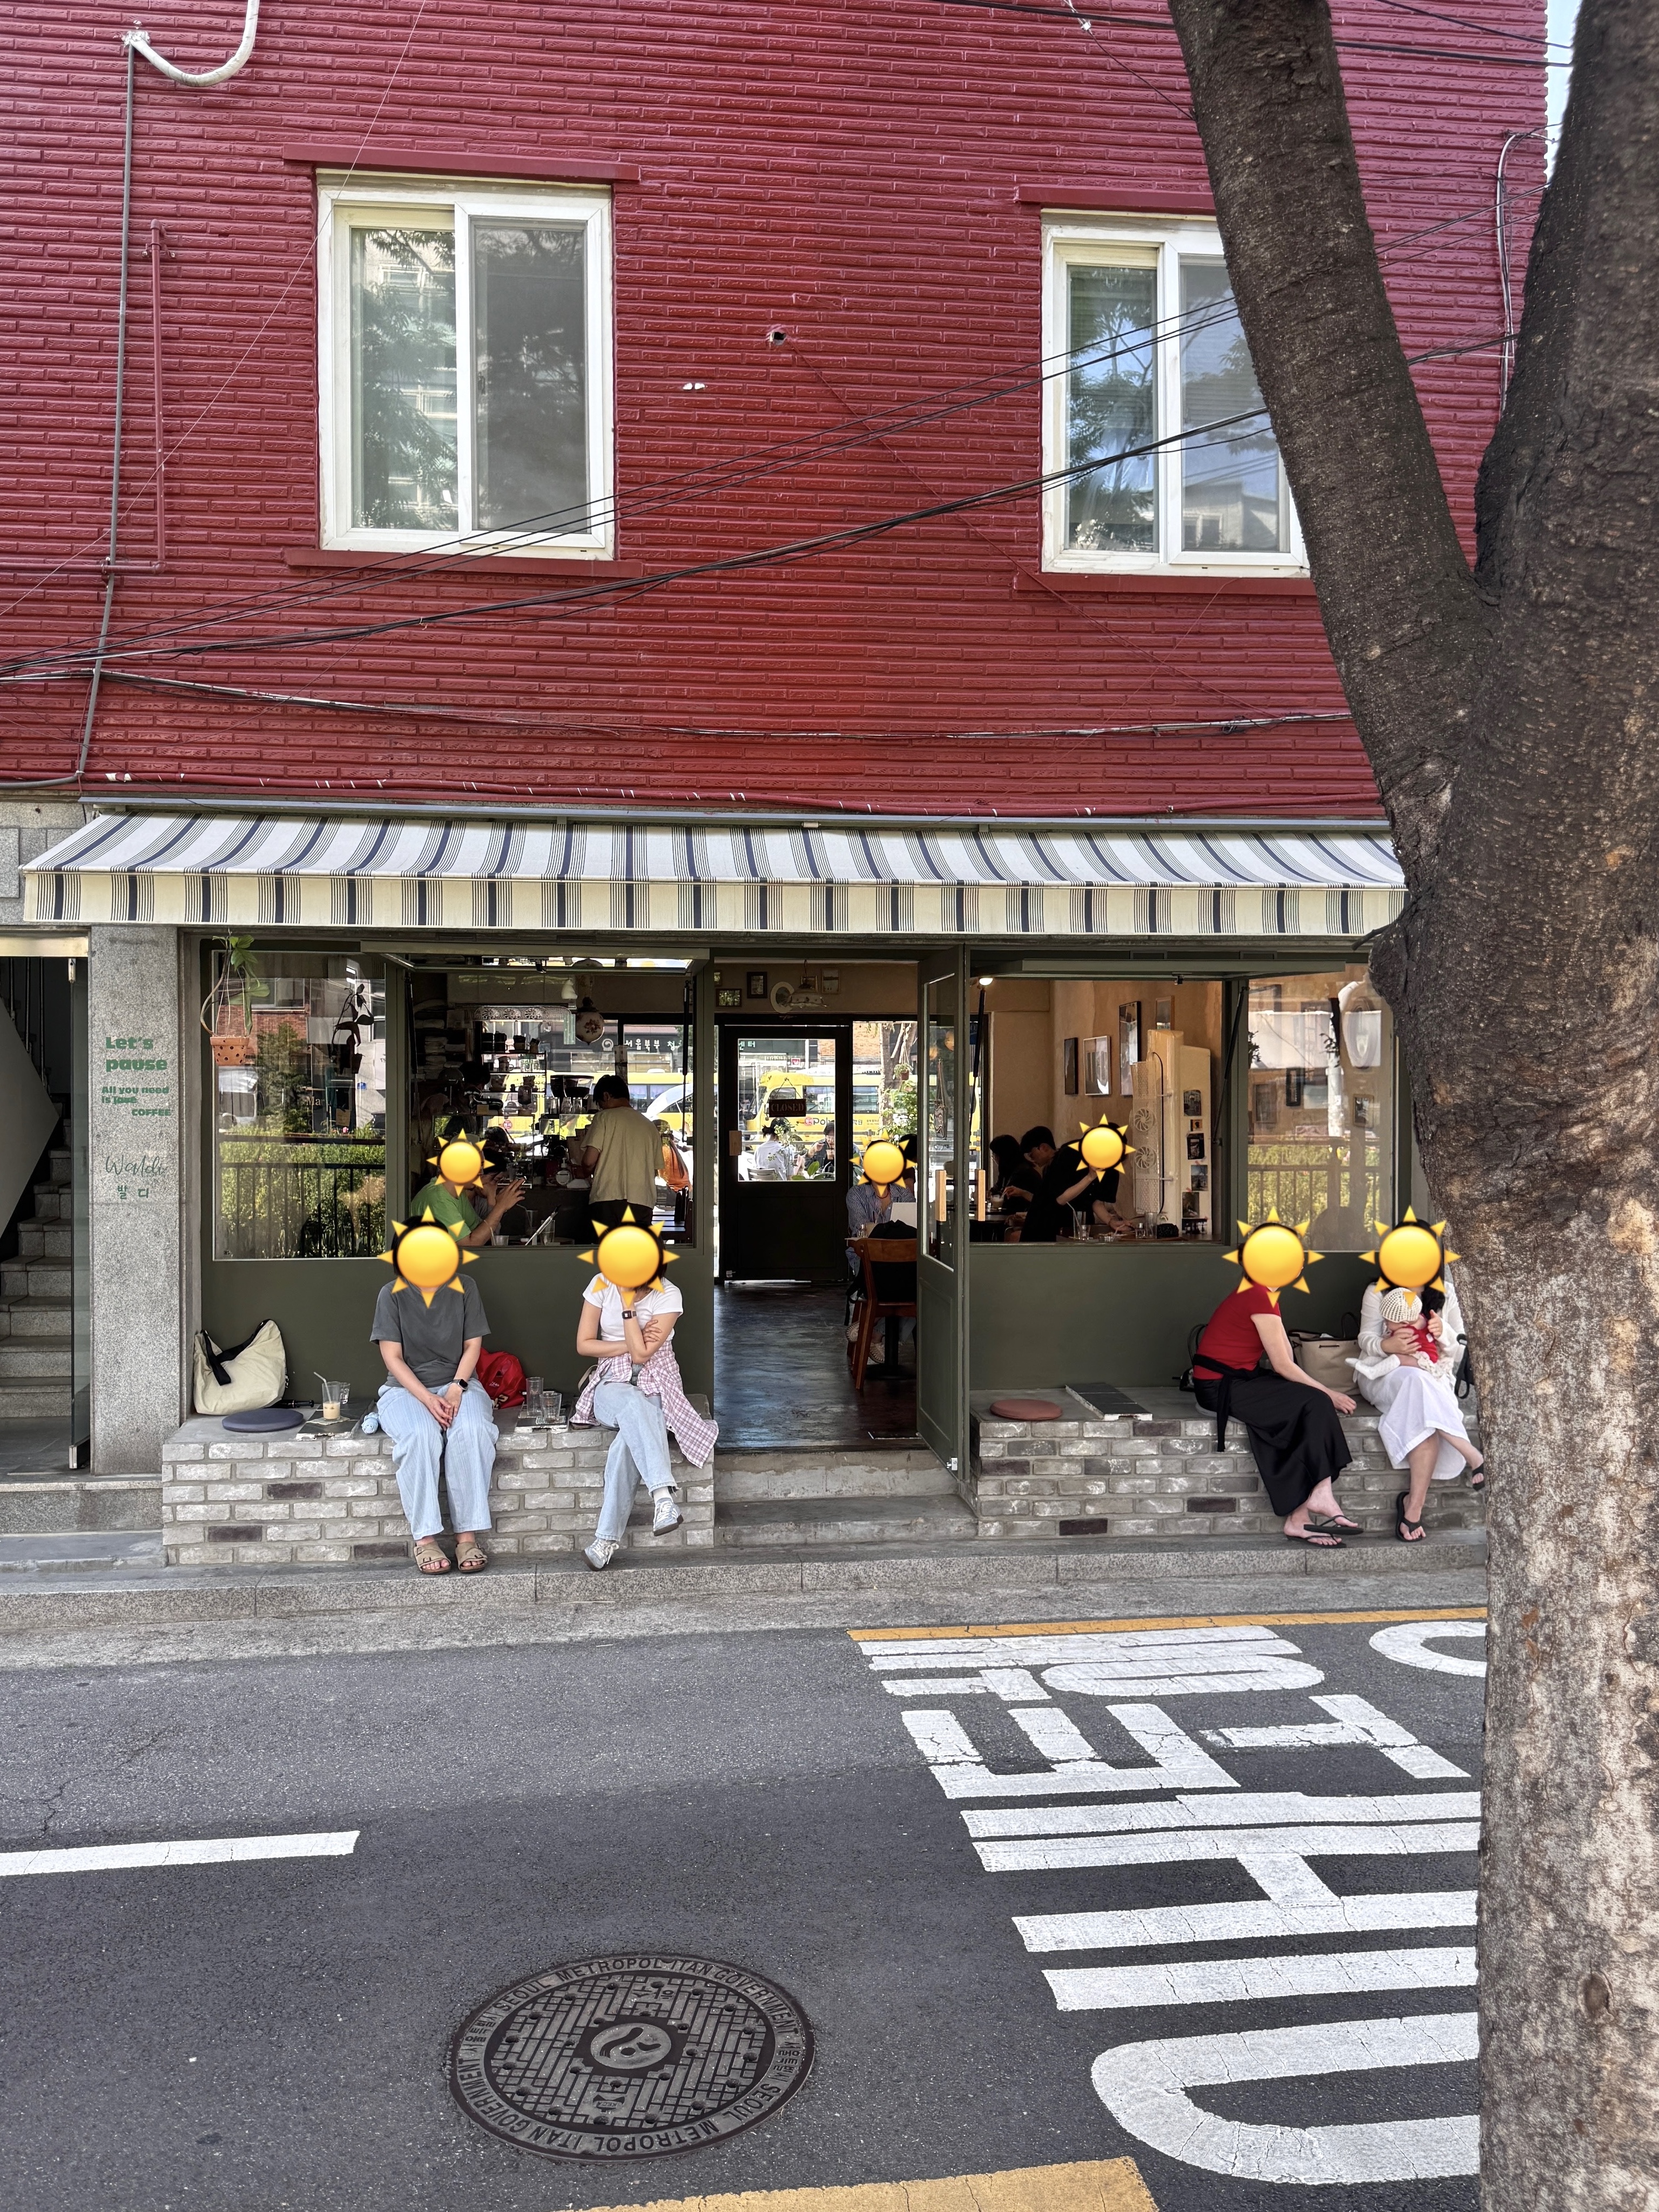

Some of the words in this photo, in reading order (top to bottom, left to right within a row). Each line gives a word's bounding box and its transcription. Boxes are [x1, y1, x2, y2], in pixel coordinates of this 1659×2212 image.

[106, 1036, 153, 1049] Let's
[624, 1038, 660, 1051] 서울북부
[106, 1059, 167, 1072] pause
[141, 1085, 170, 1094] need
[771, 1103, 805, 1112] CLOSED
[492, 1980, 551, 2012] SEOUL
[713, 1970, 799, 2034] GOVERNMENT
[458, 2058, 530, 2133] GOVERNMENT
[722, 2083, 781, 2121] SEOUL
